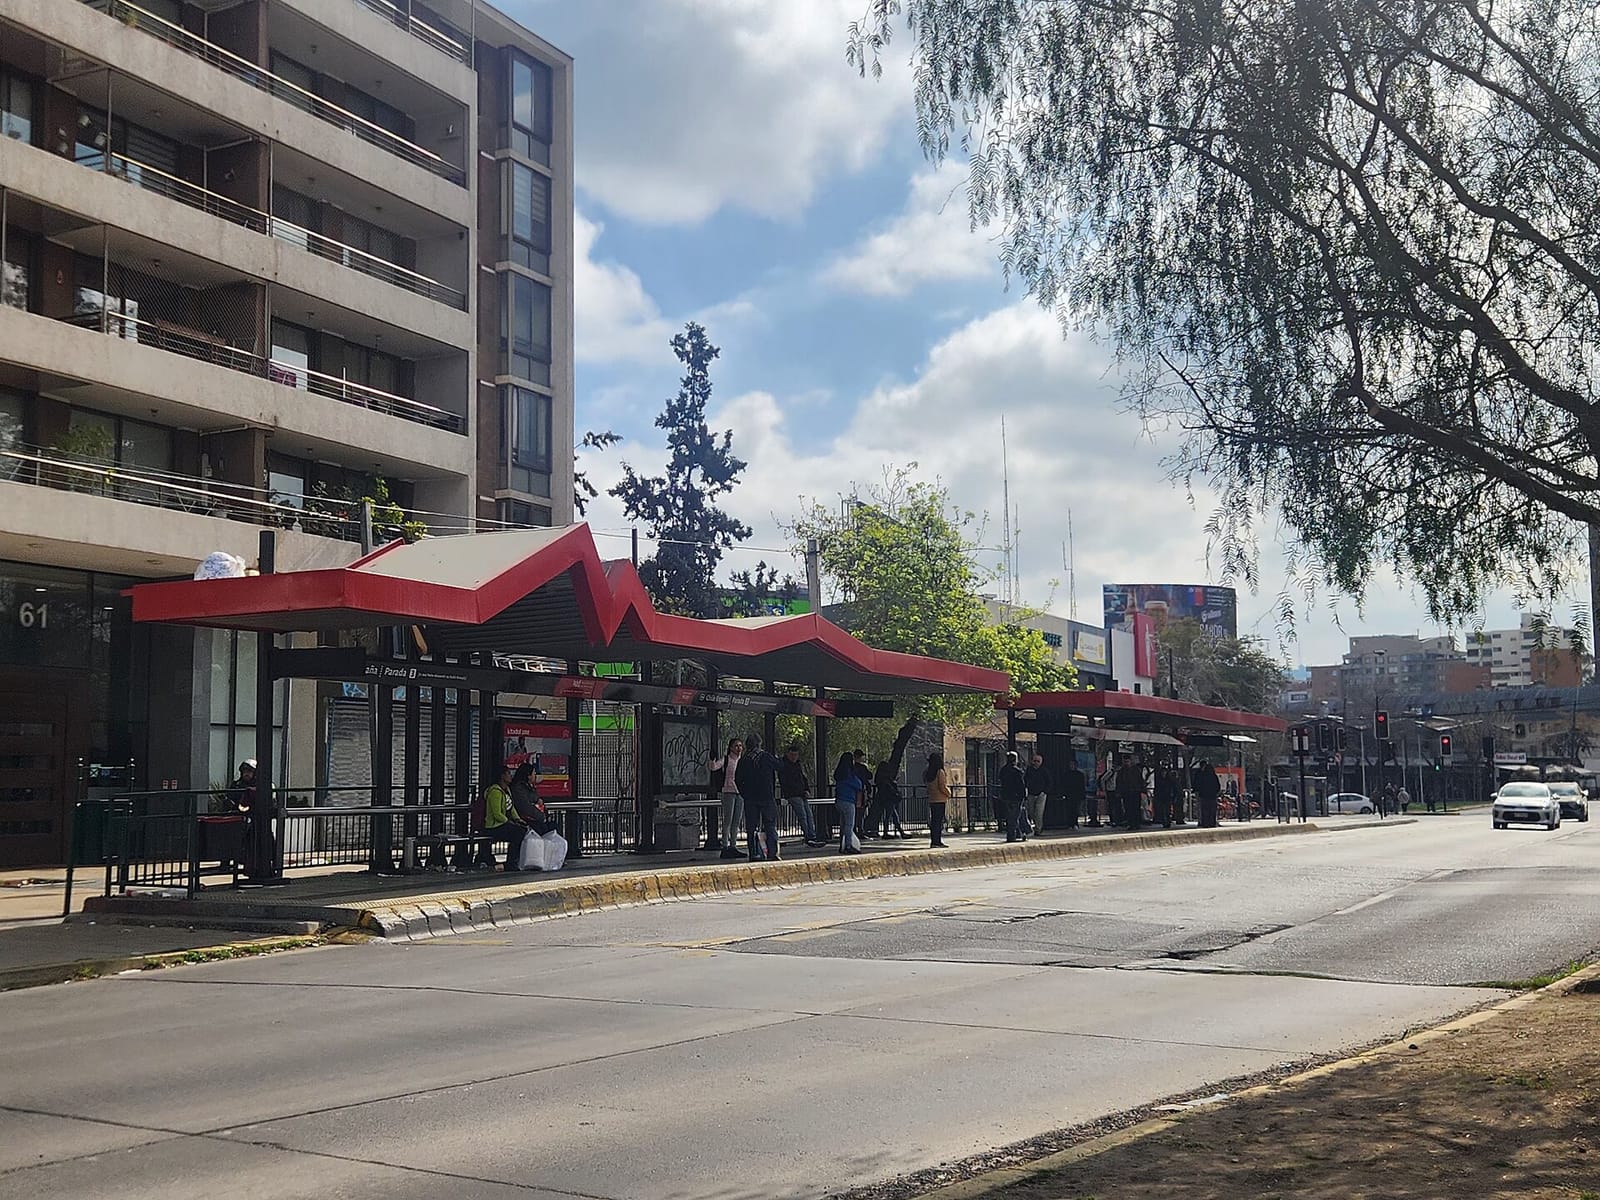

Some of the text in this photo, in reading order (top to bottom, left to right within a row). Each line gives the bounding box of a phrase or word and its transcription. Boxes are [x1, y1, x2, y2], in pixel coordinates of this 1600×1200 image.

[20, 602, 47, 628] 61
[1042, 632, 1063, 647] OFFEE
[384, 667, 407, 677] Parada
